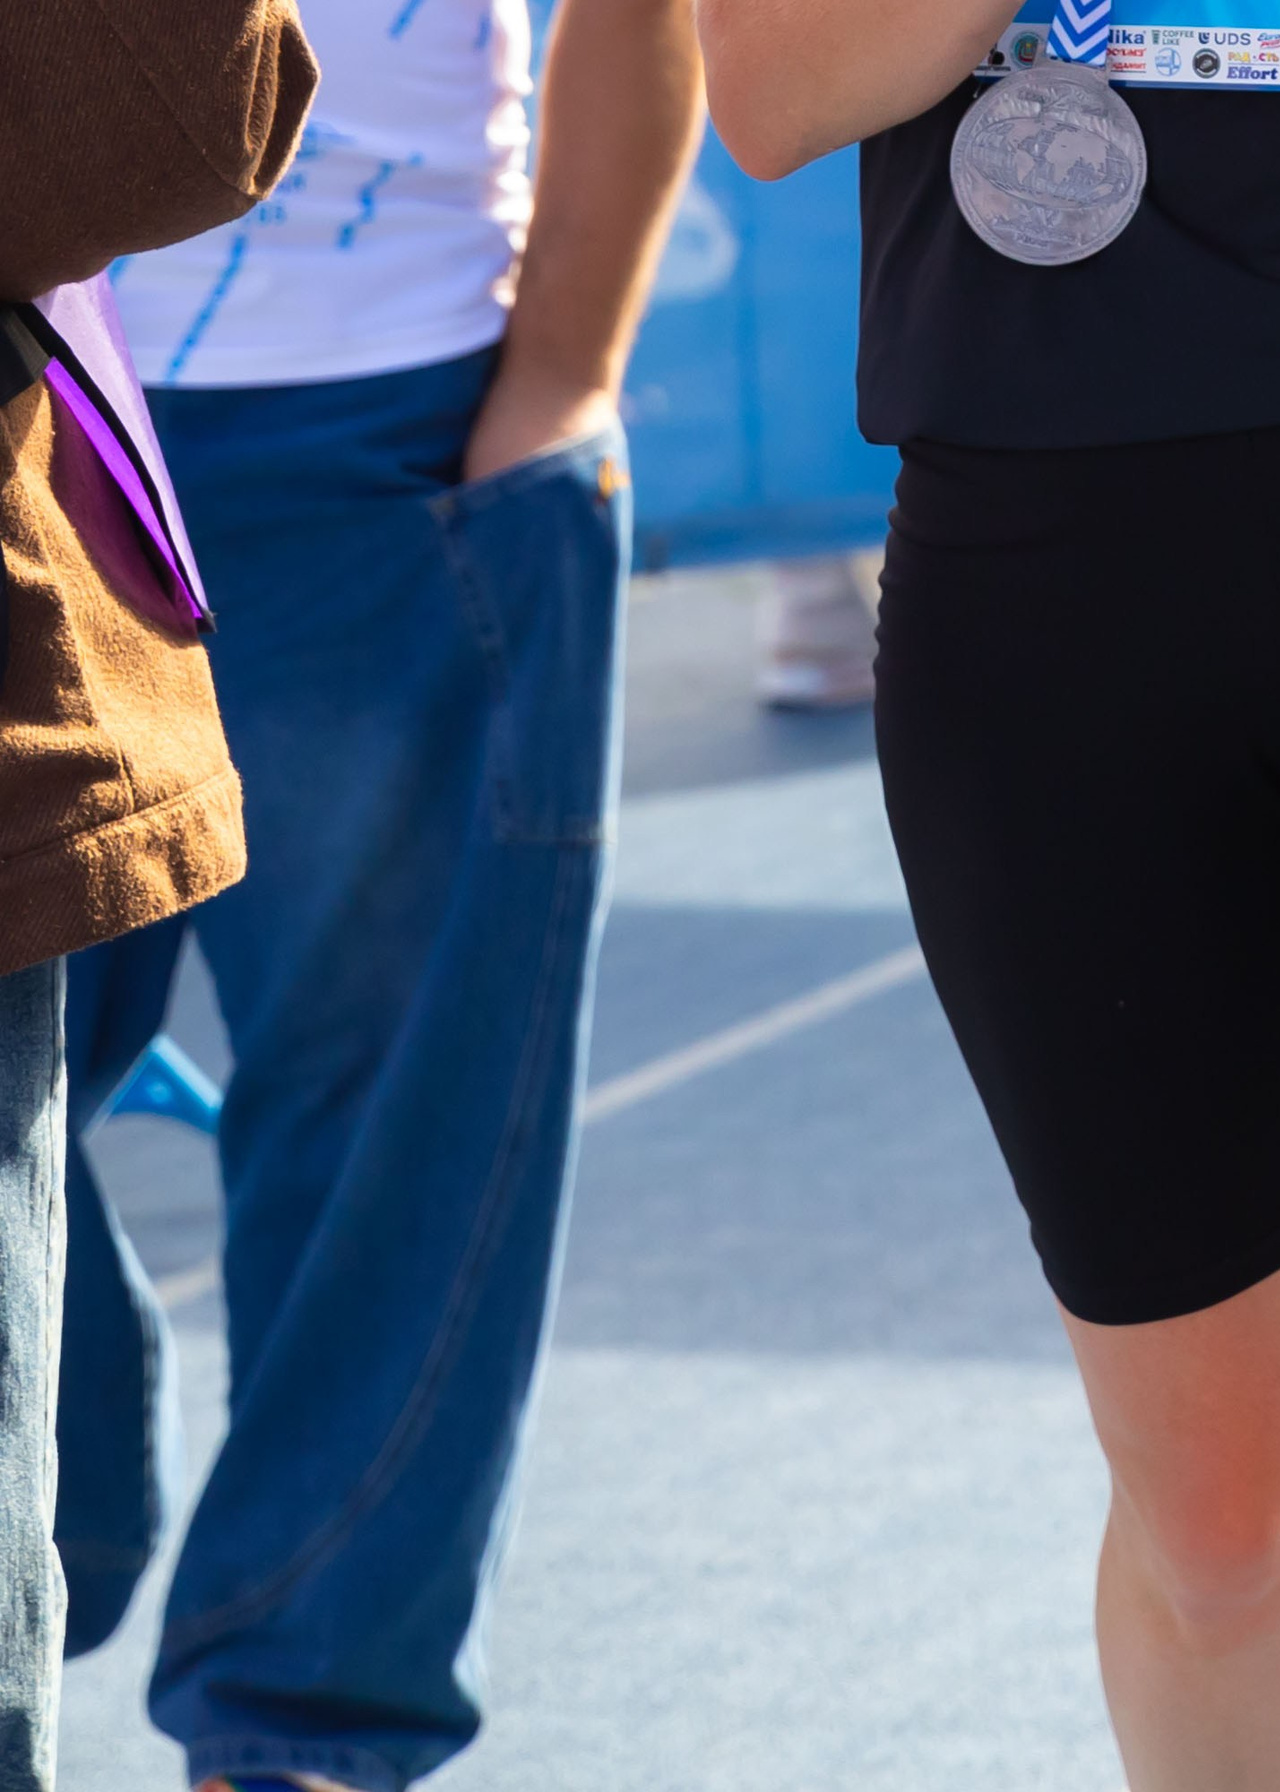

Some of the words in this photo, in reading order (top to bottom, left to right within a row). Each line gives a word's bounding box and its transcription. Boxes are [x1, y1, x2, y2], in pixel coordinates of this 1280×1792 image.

[1161, 29, 1194, 38] COFFEE
[1161, 38, 1180, 46] LIKE
[1214, 33, 1251, 46] UDS
[1227, 66, 1279, 80] Effort
